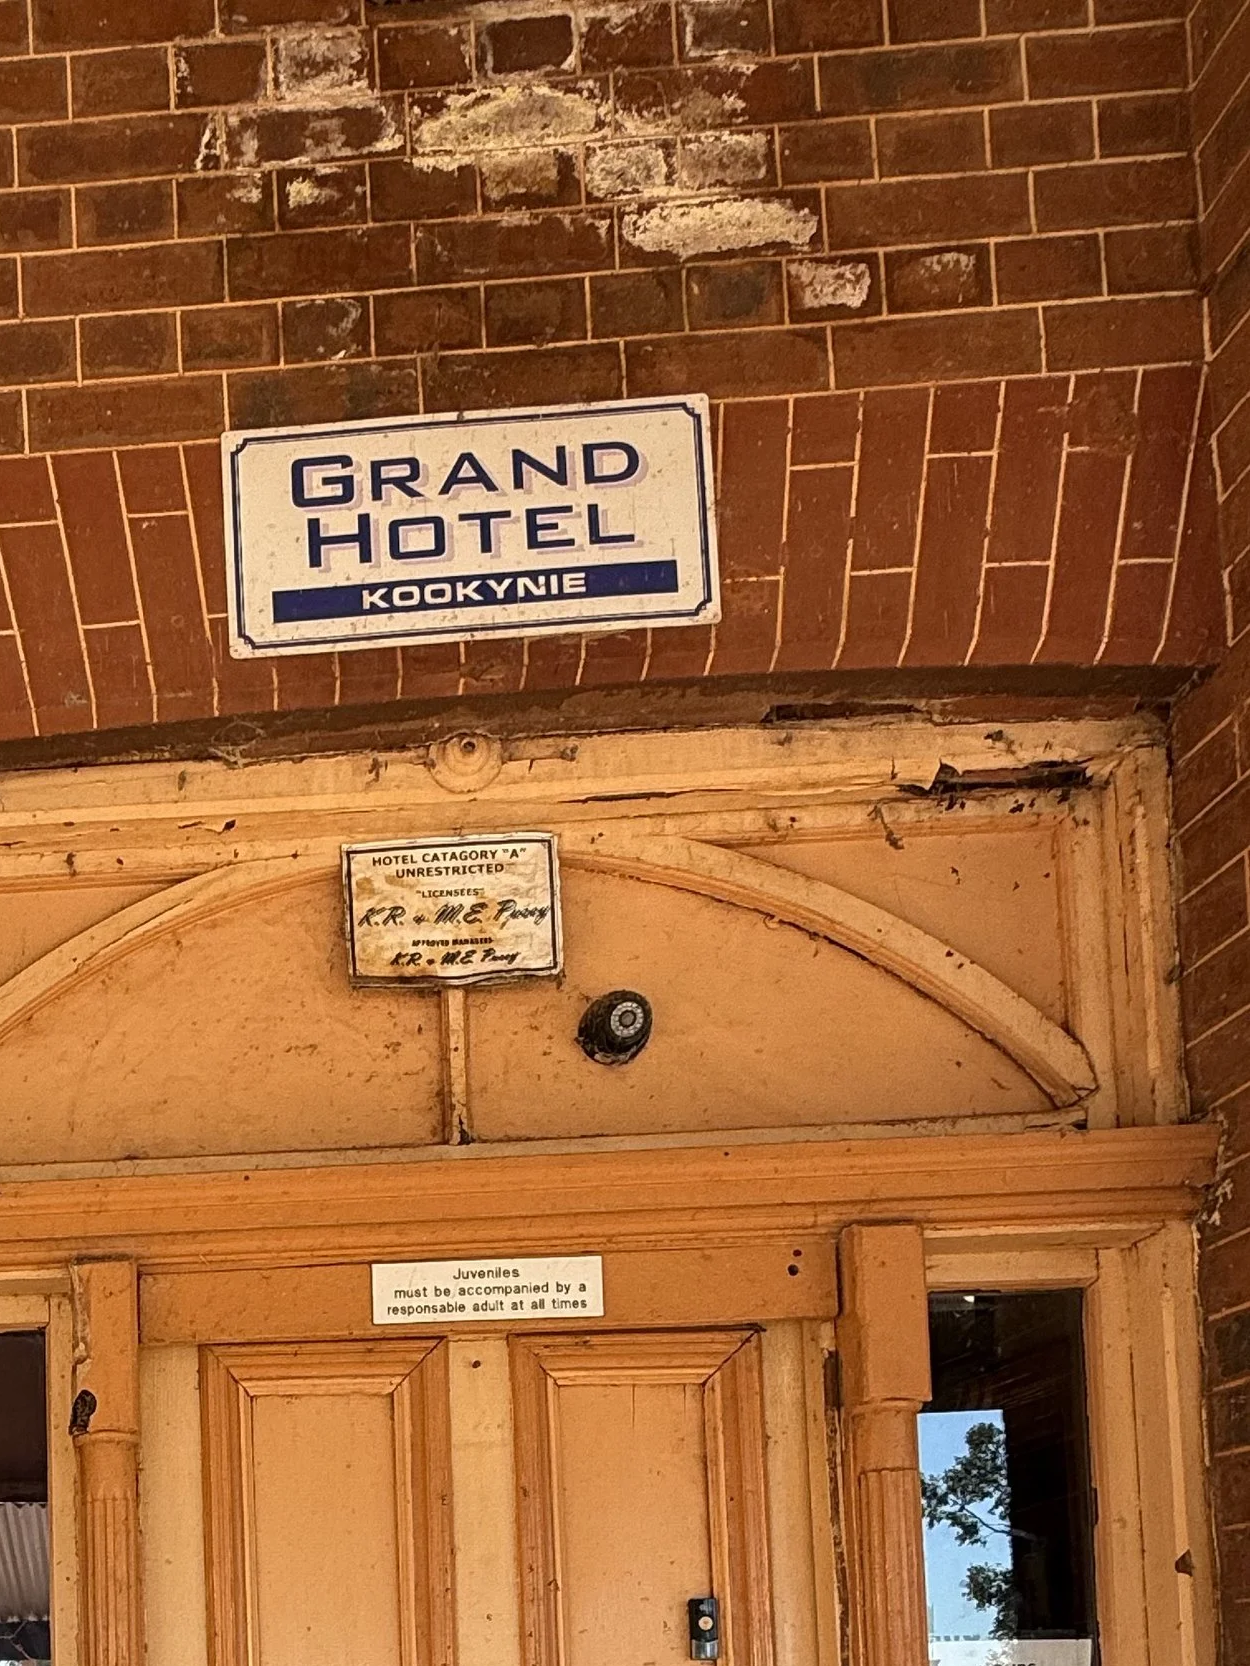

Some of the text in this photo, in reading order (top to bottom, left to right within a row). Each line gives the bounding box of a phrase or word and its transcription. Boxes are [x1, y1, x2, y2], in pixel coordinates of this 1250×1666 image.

[291, 441, 642, 509] GRAND
[307, 503, 638, 569] HOTEL
[361, 572, 587, 610] KOOKYNIE
[372, 854, 417, 866] HOTEL
[422, 849, 498, 863] CATAGORY
[396, 863, 504, 878] UNRESTRICTED
[453, 1266, 520, 1281] Juveniles
[394, 1281, 587, 1299] must be accompanied by a
[387, 1297, 587, 1316] responsable adult at all times
